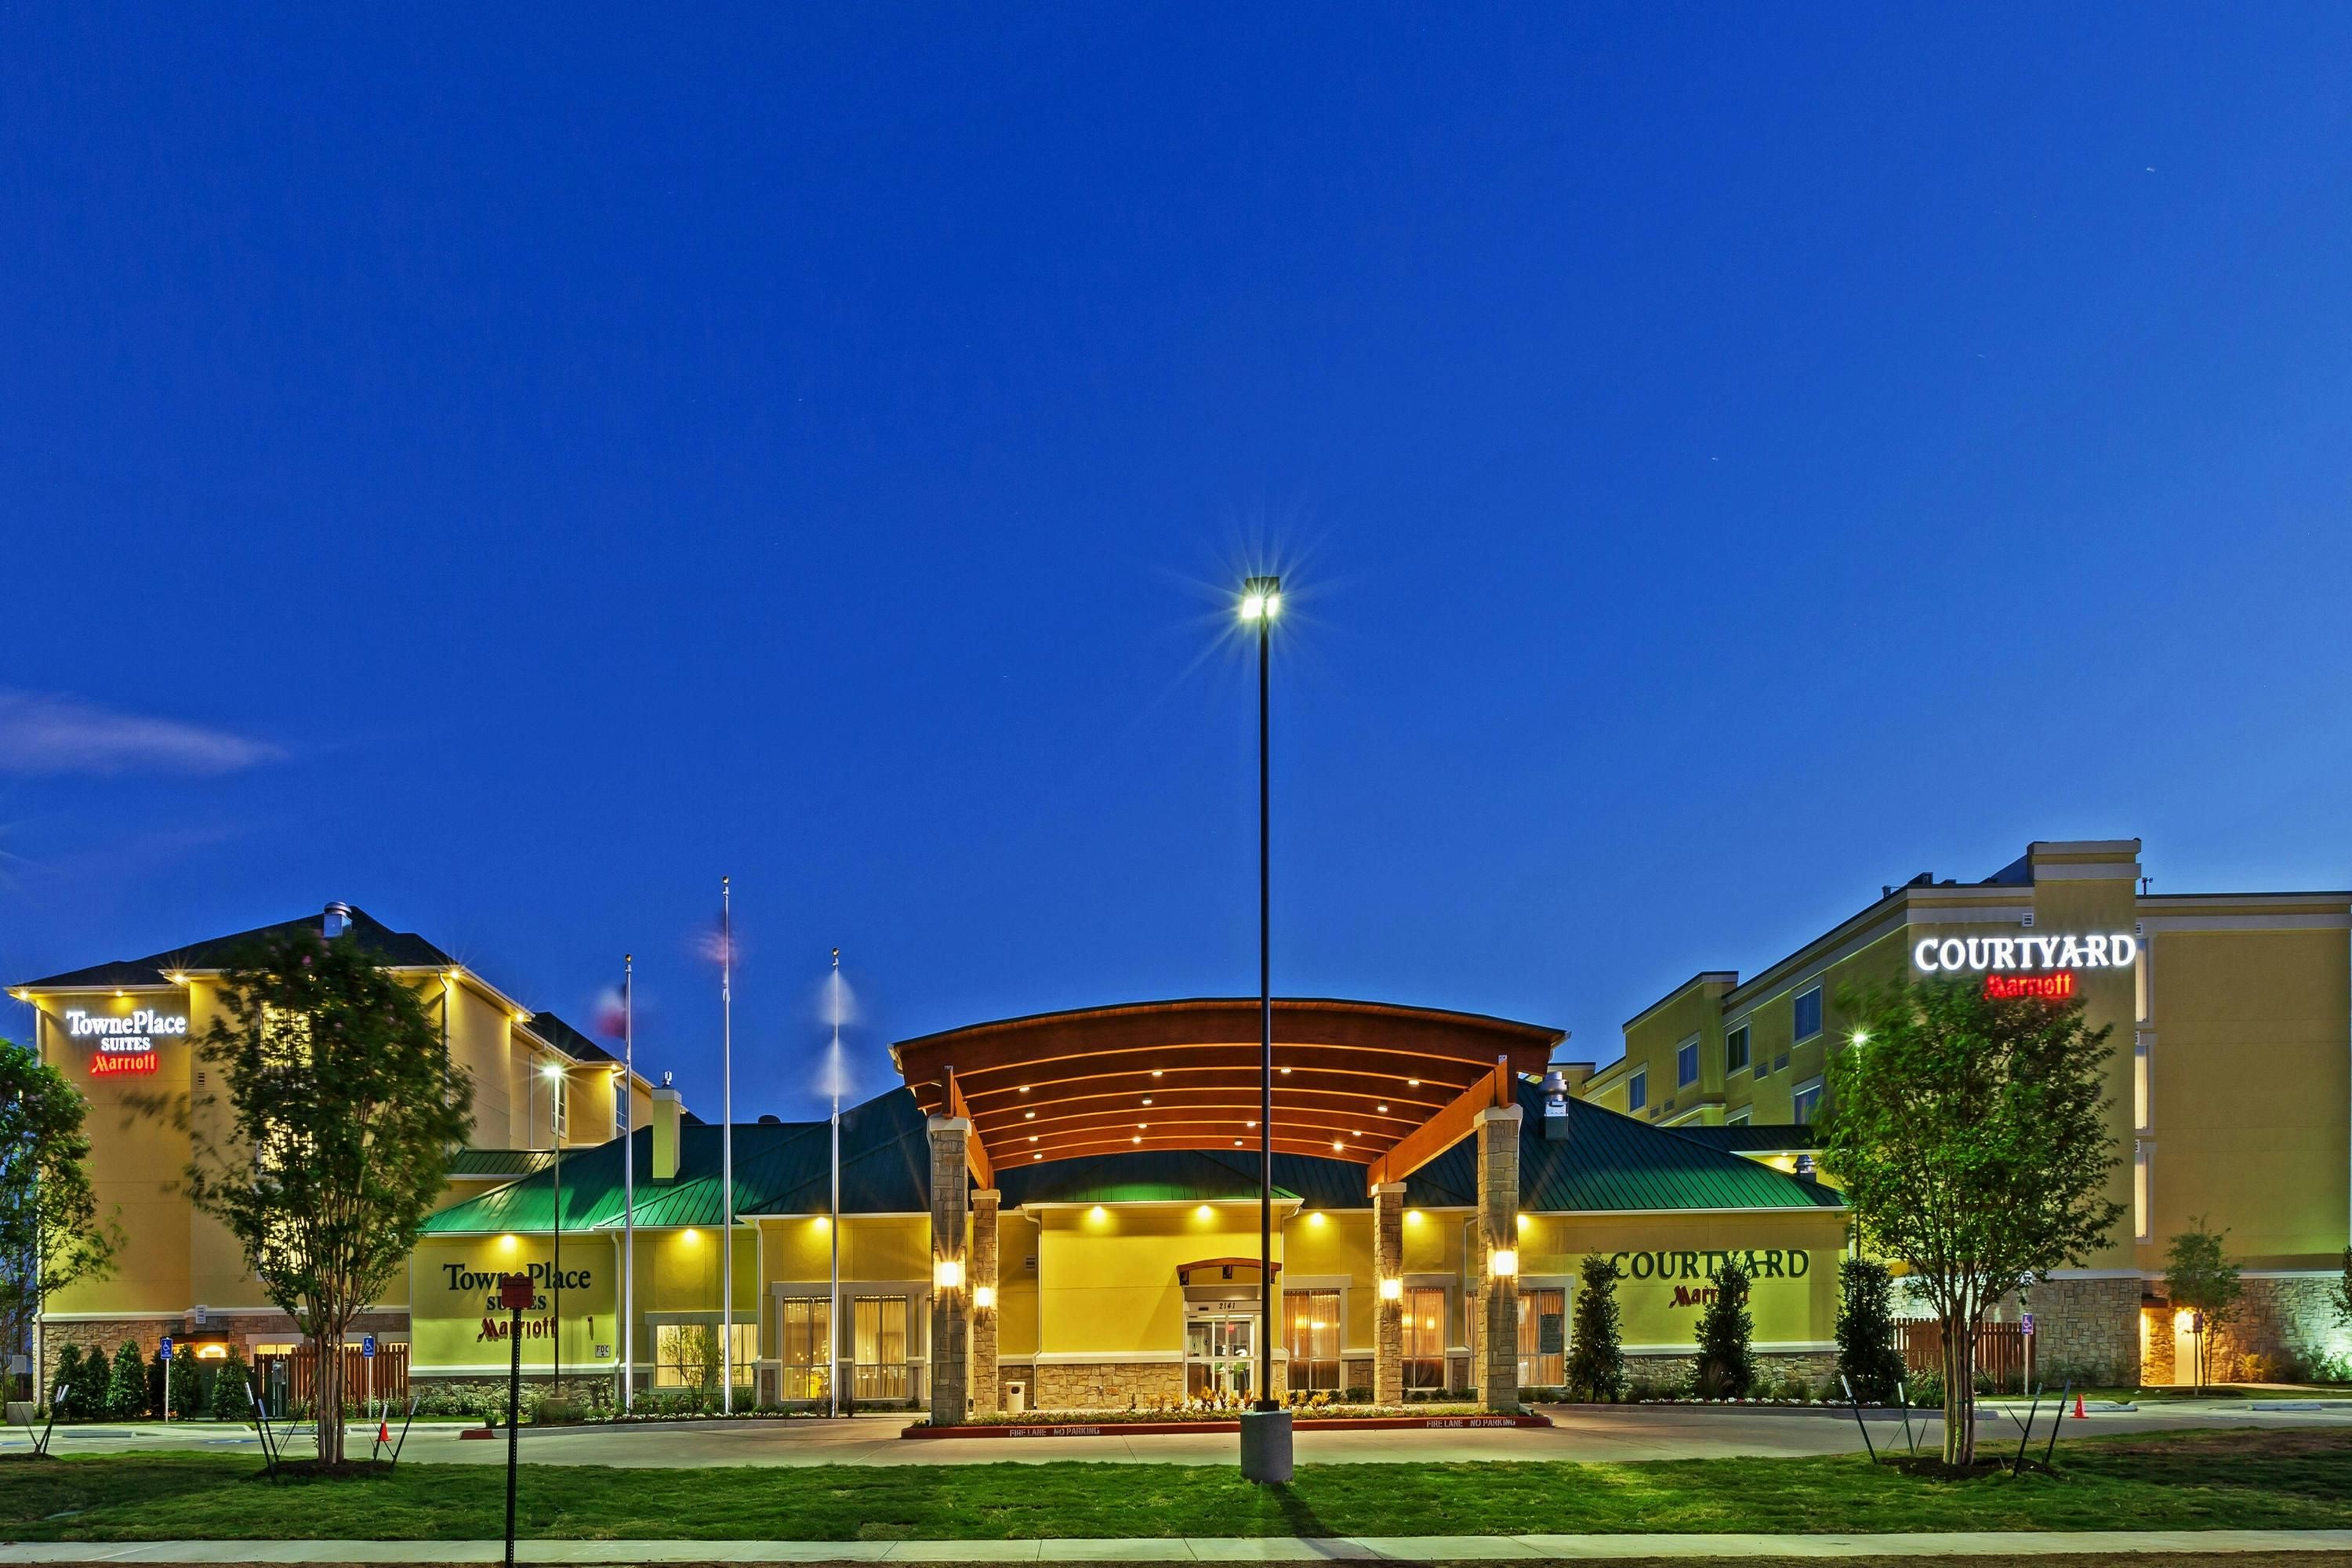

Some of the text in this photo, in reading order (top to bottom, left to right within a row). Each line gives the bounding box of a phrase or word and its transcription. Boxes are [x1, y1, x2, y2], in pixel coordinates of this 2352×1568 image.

[1915, 935, 2136, 971] COURTYARD
[1984, 974, 2071, 1000] Marriott
[66, 1010, 186, 1035] TownePlace
[100, 1037, 151, 1051] SUITES
[92, 1054, 156, 1073] Marriott
[1610, 1250, 1809, 1279] COURTYARD
[596, 1345, 609, 1353] FDC
[1009, 1426, 1100, 1437] FIRE LANE NO PARKING
[1444, 1419, 1463, 1428] LANE
[1483, 1418, 1516, 1427] PARKING
